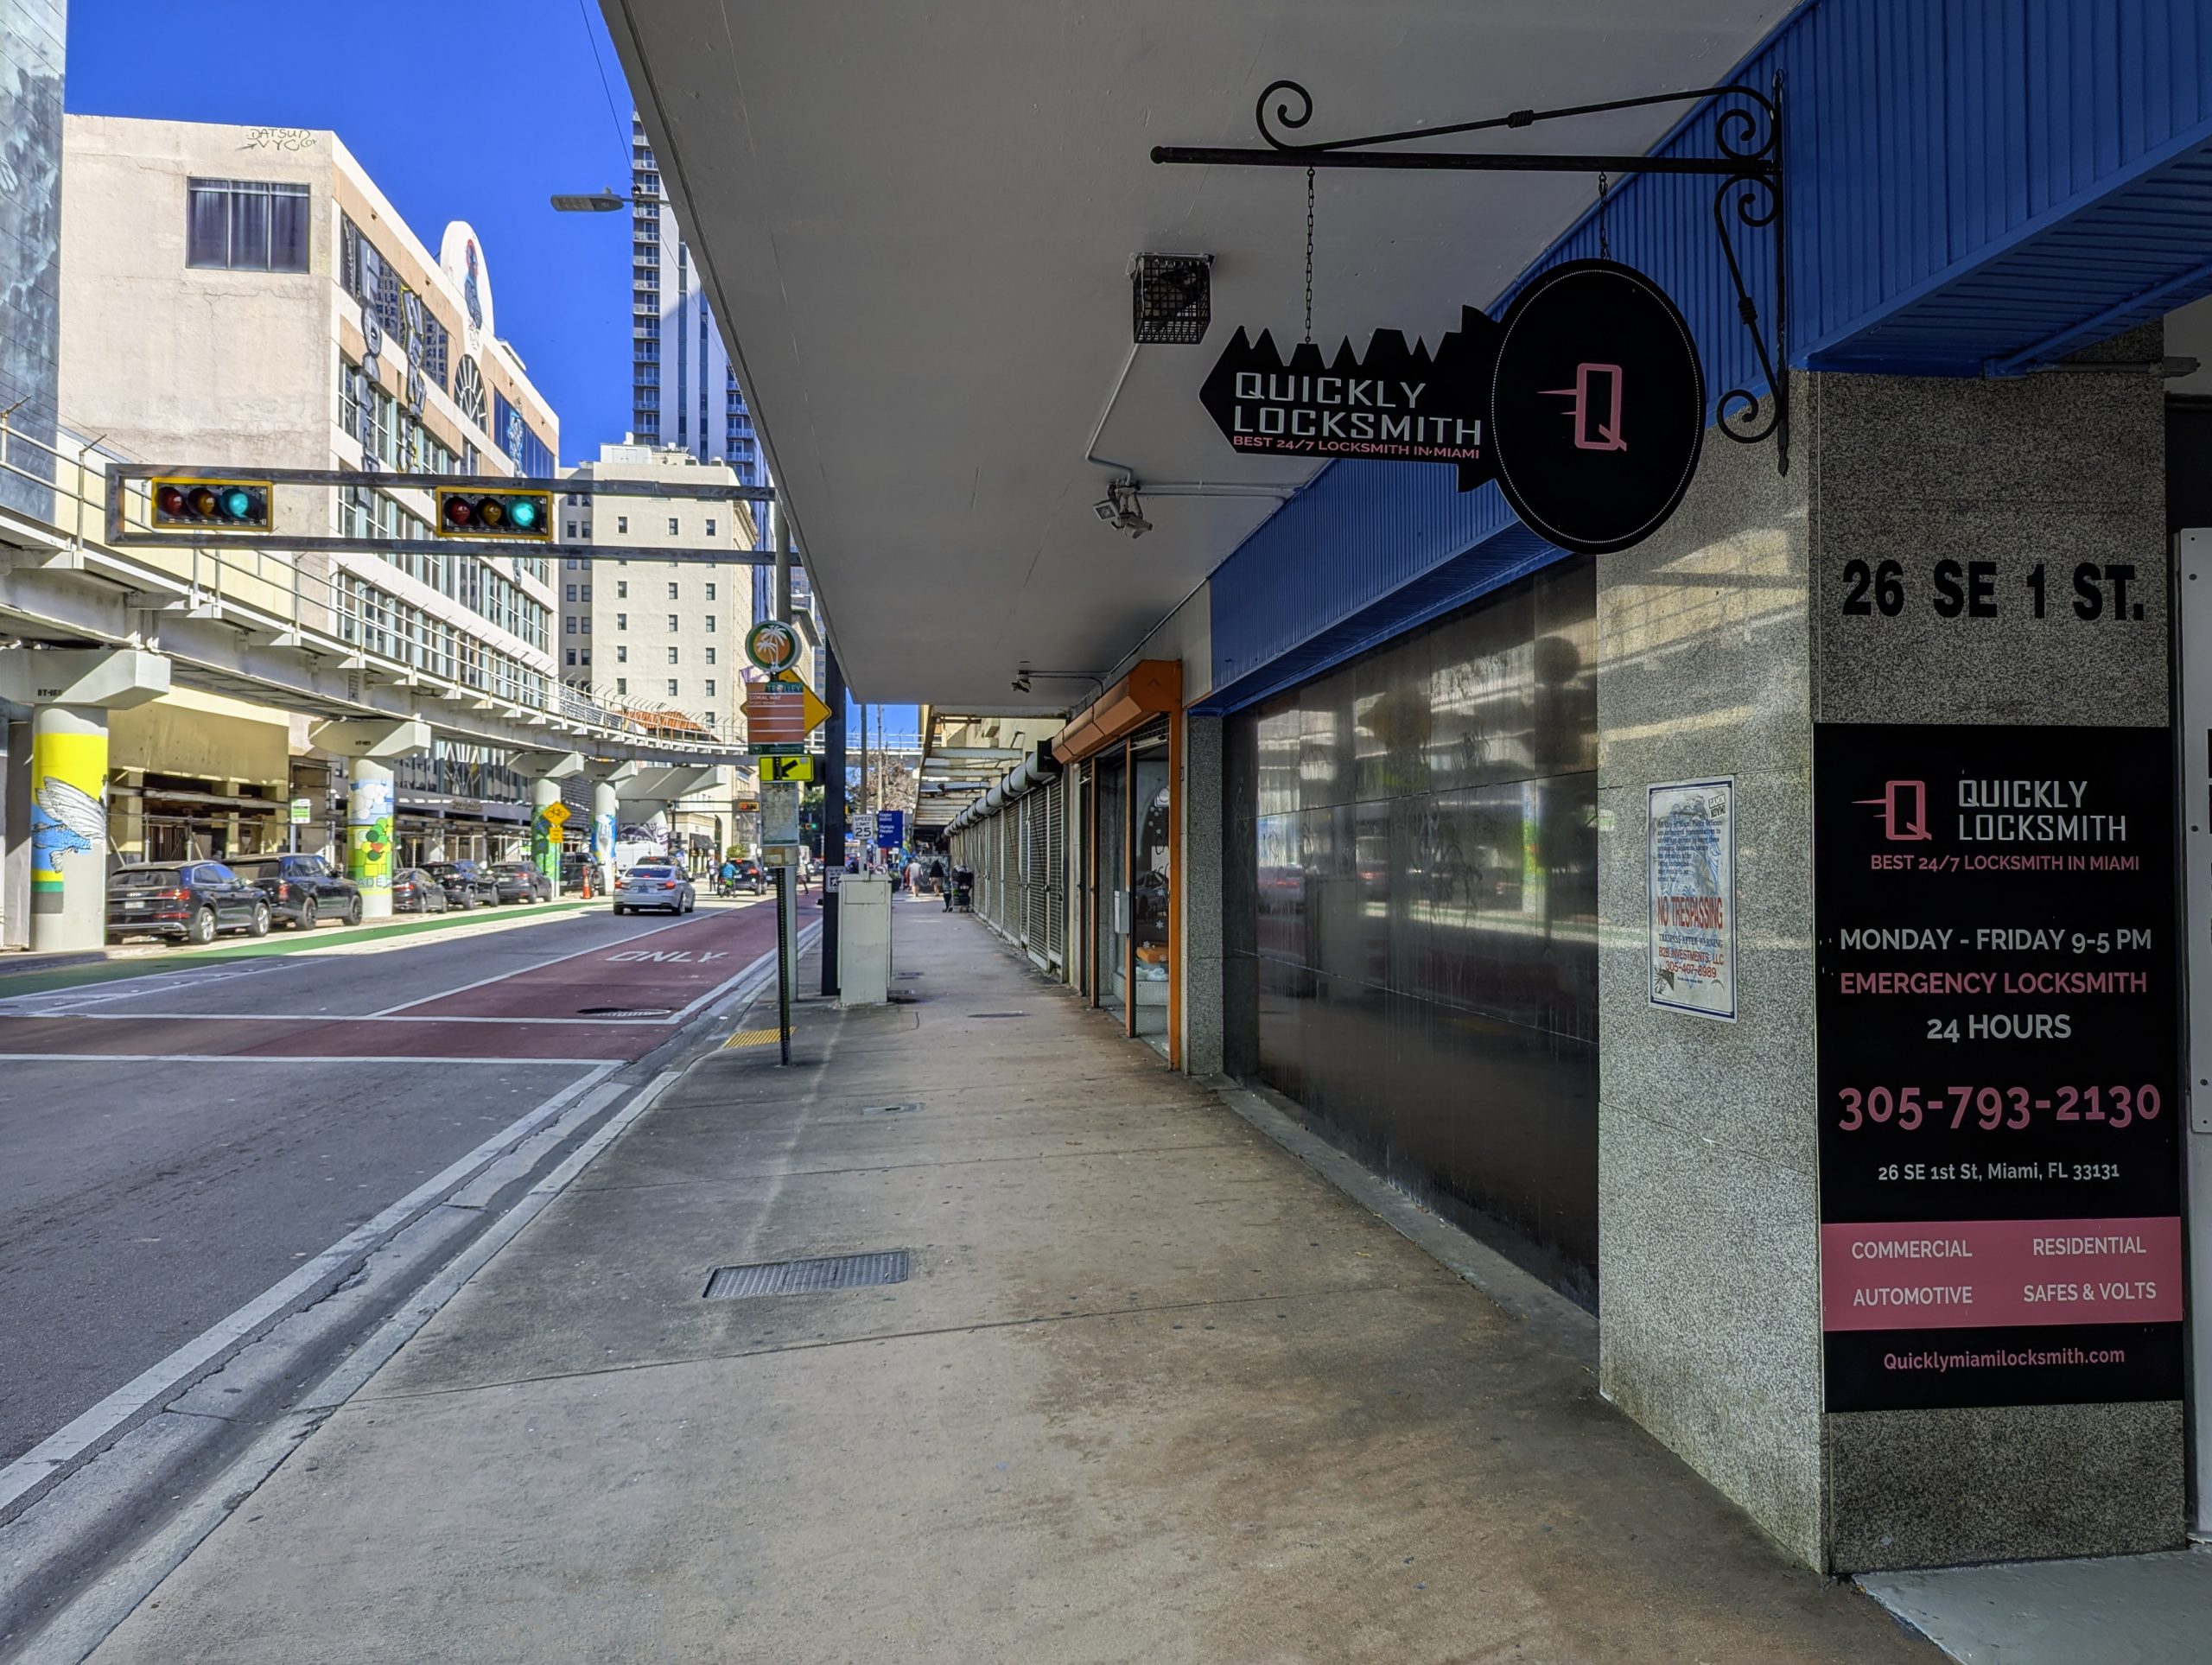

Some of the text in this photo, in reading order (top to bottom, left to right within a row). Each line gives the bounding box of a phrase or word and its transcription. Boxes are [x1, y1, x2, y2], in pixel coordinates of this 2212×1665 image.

[1236, 372, 1427, 409] QUICKLY
[1234, 405, 1481, 446] LOCKSMITH
[1233, 435, 1480, 460] BEST 24/7 LOCKSMITH IN MIAMI
[1842, 559, 2144, 620] 26 SE 1 ST.
[1958, 779, 2088, 809] QUICKLY
[855, 827, 871, 837] 25
[1958, 814, 2126, 842] LOCKSMITH
[1870, 855, 2139, 873] BEST 24/7 LOCKSMITH IN MIAMI
[1657, 896, 1723, 930] NO TRESPASSING
[1658, 934, 1723, 949] TRESPASS AFTER WARNING
[1840, 929, 1954, 950] MONDAY
[1976, 929, 2066, 950] FRIDAY
[2071, 933, 2110, 954] 9-5
[2117, 929, 2152, 950] PM
[605, 950, 729, 963] ONLY
[1658, 946, 1669, 957] B2B
[1713, 954, 1724, 965] LLC
[1665, 960, 1717, 978] 305-407-8989
[1840, 972, 2147, 994] EMERGENCY LOCKSMITH
[1927, 1014, 2072, 1043] 24 HOURS
[1838, 1084, 2161, 1131] 305-793-2130
[1878, 1162, 2120, 1181] 26 SE 1st St, Miami, FL 33131
[1852, 1240, 1973, 1260] COMMERCIAL
[2032, 1236, 2147, 1256] RESIDENTIAL
[1853, 1286, 1973, 1306] AUTOMOTIVE
[2023, 1281, 2157, 1303] SAFES & VOLTS
[1884, 1347, 2126, 1372] Quicklymiamilocksmith.com
